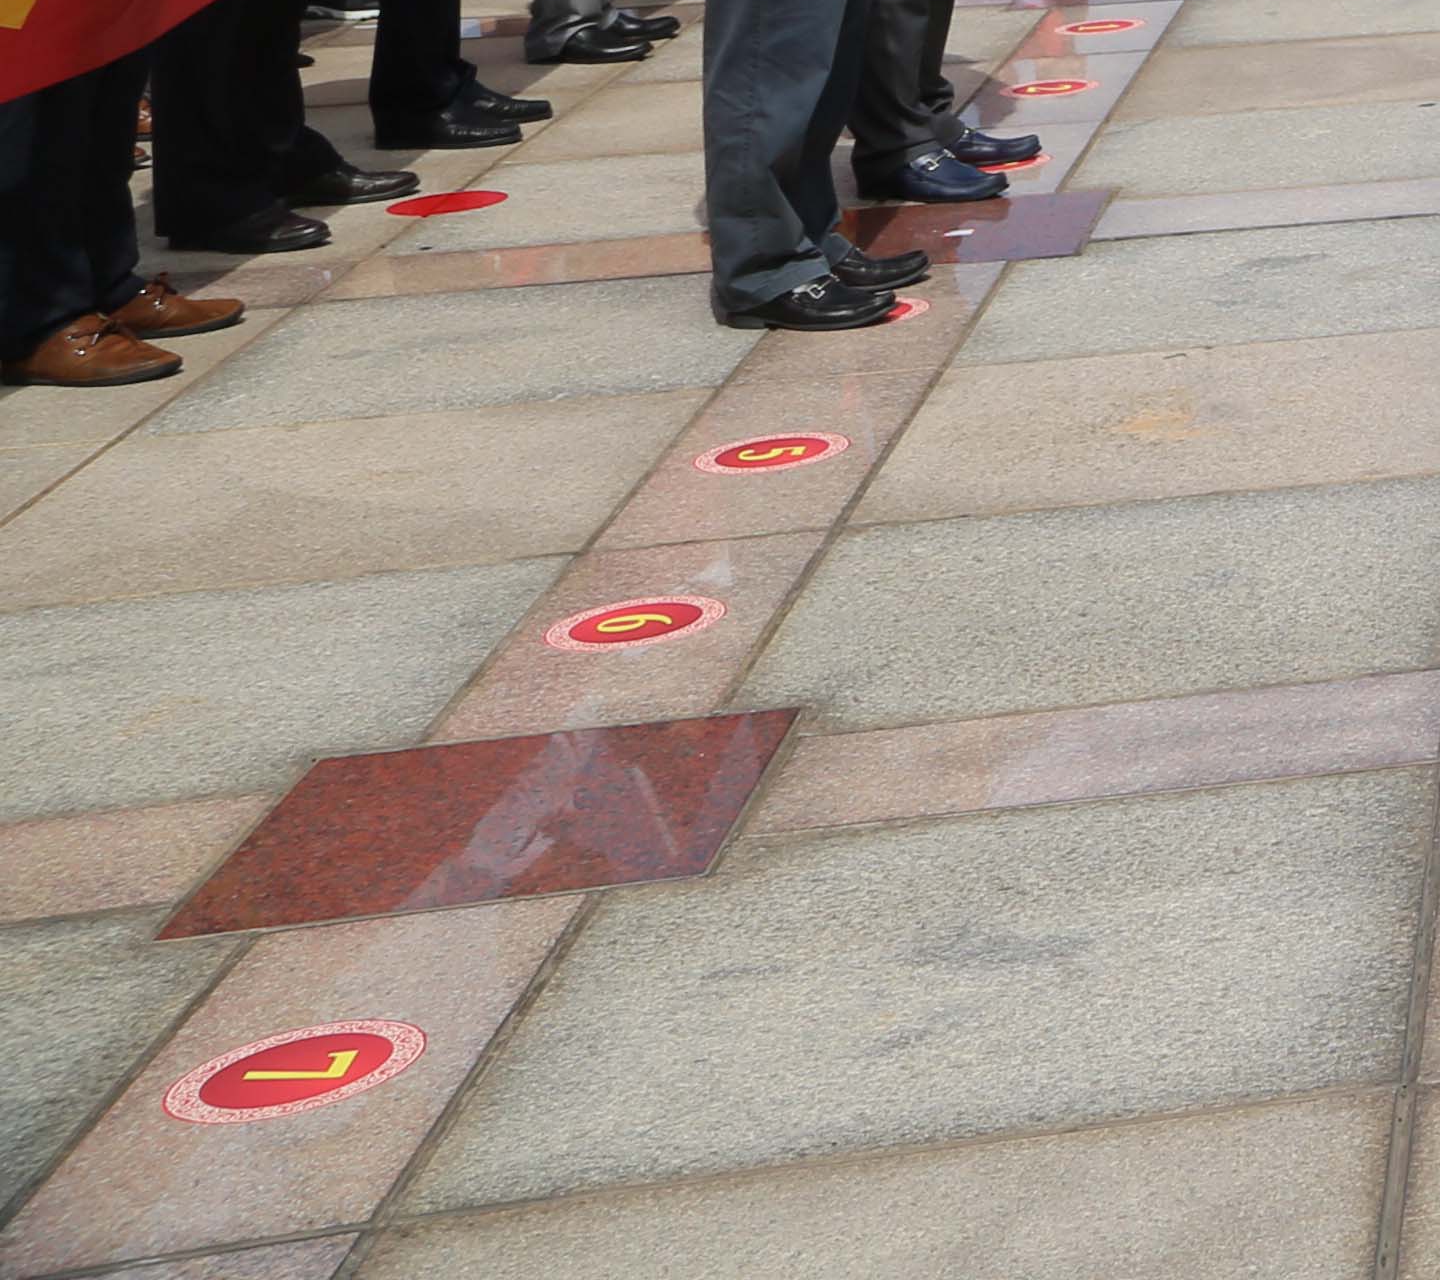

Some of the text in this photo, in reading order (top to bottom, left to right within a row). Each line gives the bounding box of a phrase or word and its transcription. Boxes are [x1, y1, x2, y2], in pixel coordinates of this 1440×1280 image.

[738, 446, 806, 461] 5
[597, 613, 672, 633] 6
[243, 1050, 359, 1080] 7
